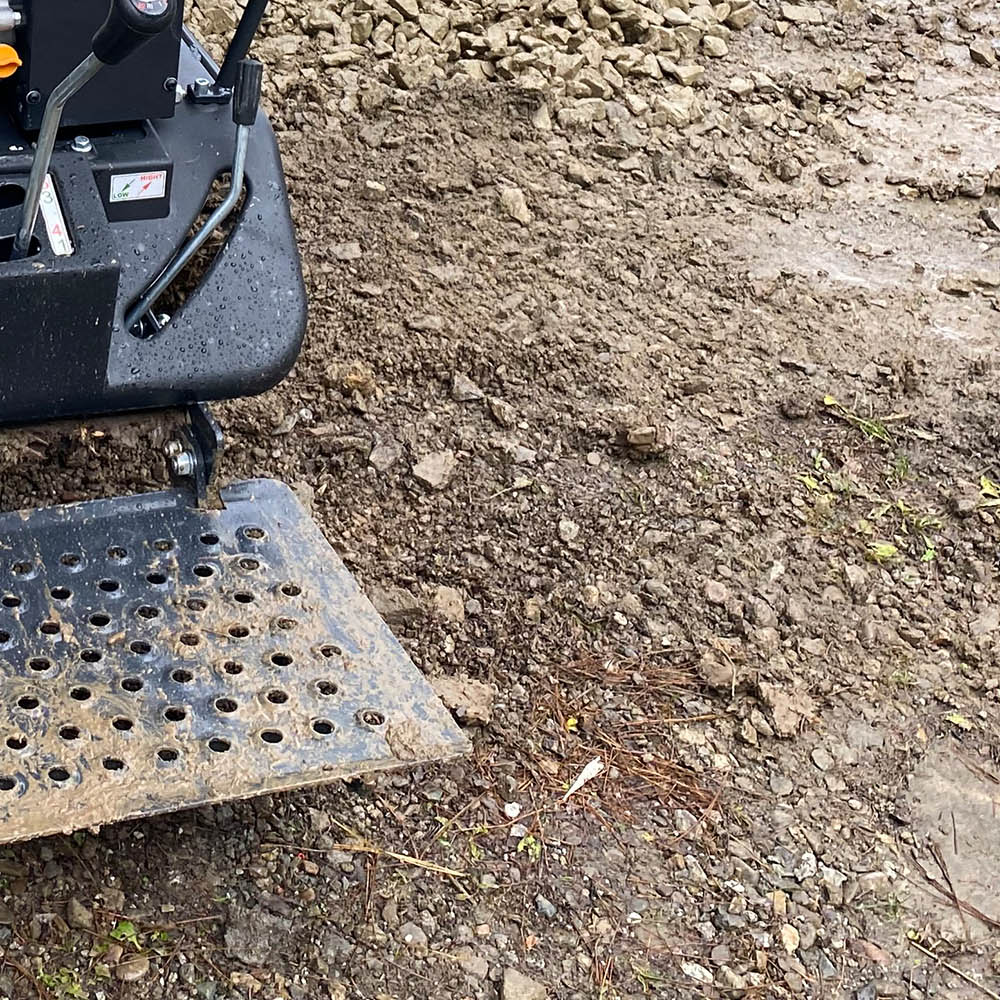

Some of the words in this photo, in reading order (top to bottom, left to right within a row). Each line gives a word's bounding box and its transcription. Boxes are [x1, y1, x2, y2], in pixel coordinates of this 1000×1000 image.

[42, 191, 53, 204] 3
[113, 191, 129, 199] LOW
[52, 223, 63, 236] 4
